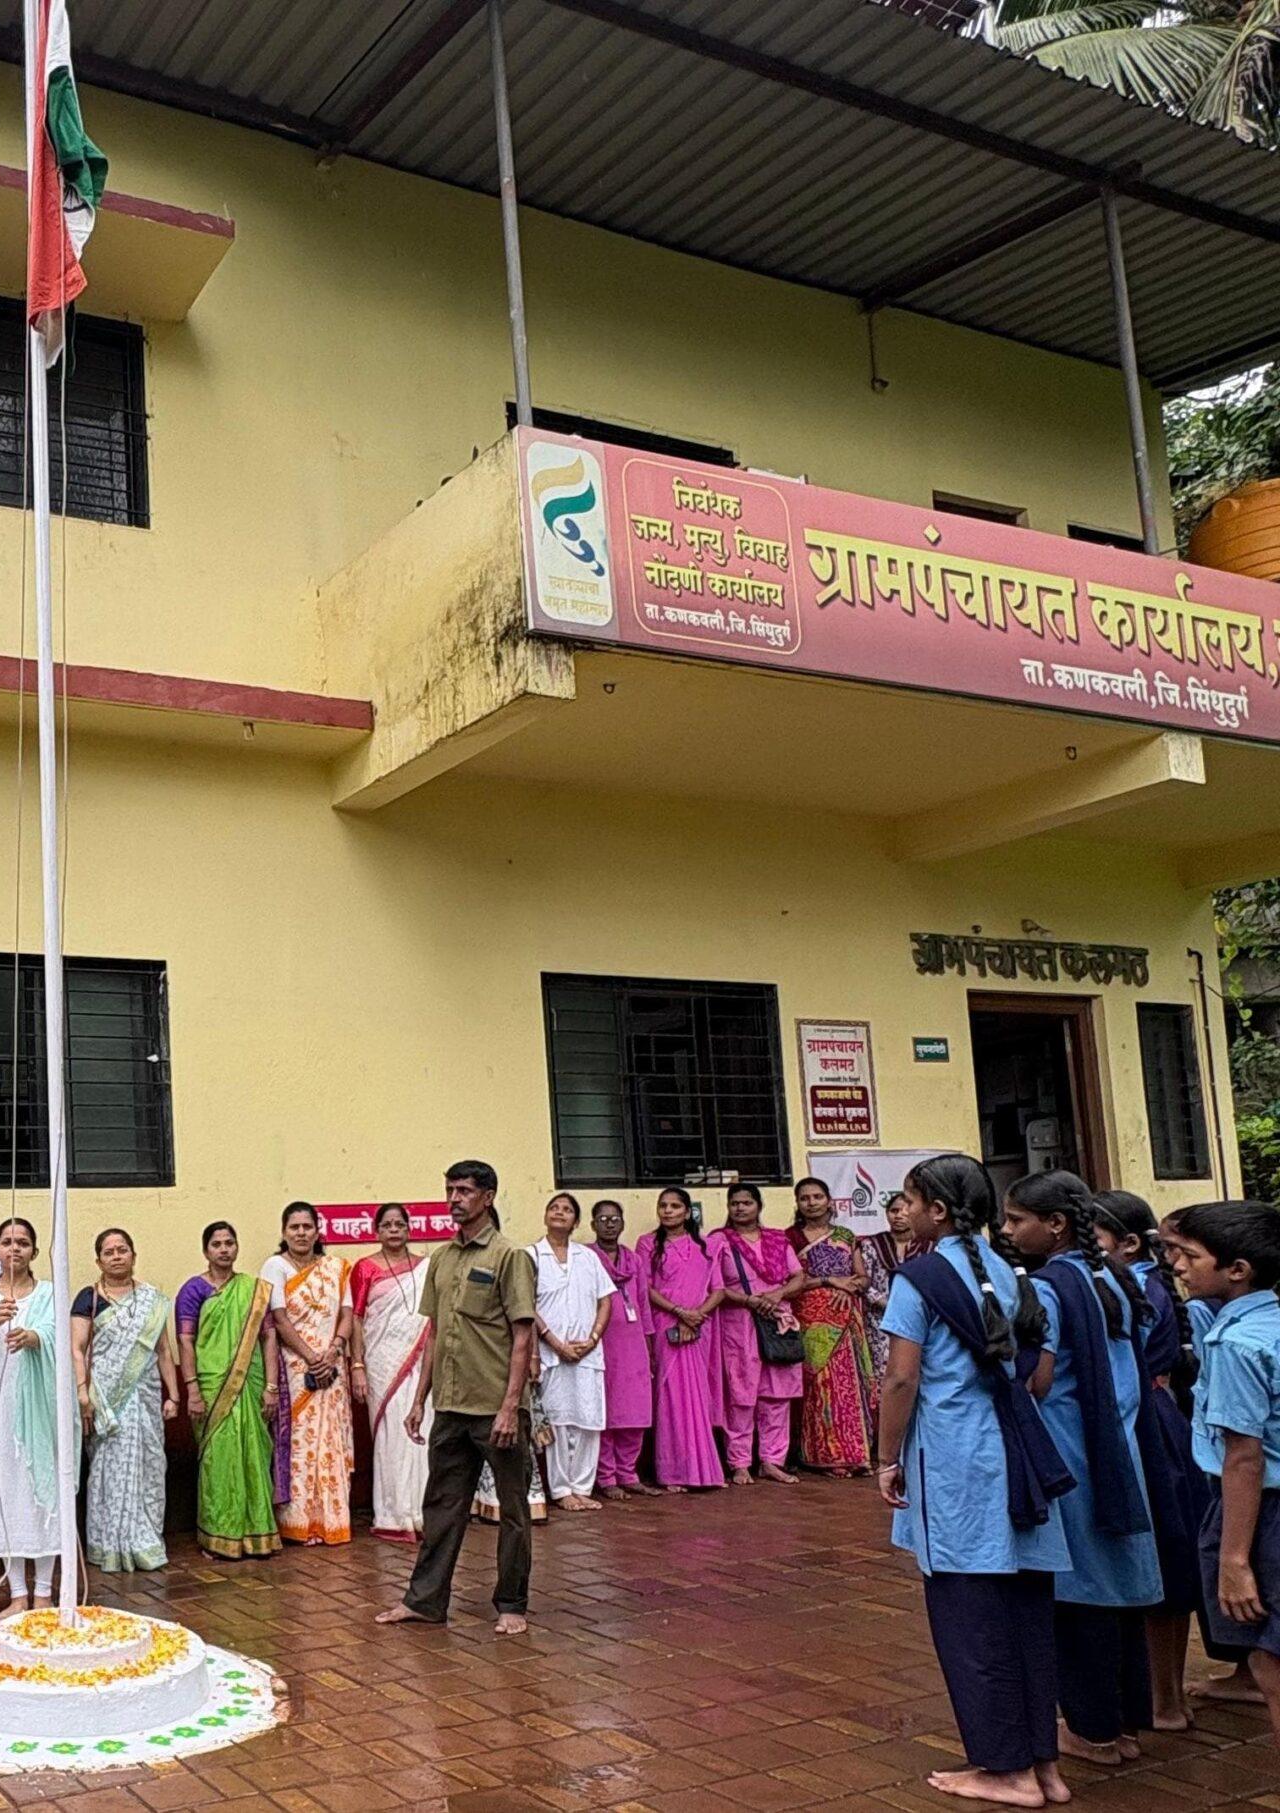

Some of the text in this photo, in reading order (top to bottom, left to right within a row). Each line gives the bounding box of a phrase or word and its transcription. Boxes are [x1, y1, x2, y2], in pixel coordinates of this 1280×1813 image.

[672, 477, 743, 520] निबंधक
[733, 526, 790, 571] विवाह
[644, 554, 786, 608] नोंदणी कार्यालय
[804, 524, 1079, 643] ग्रामपंचायत
[331, 1211, 374, 1238] वाहने
